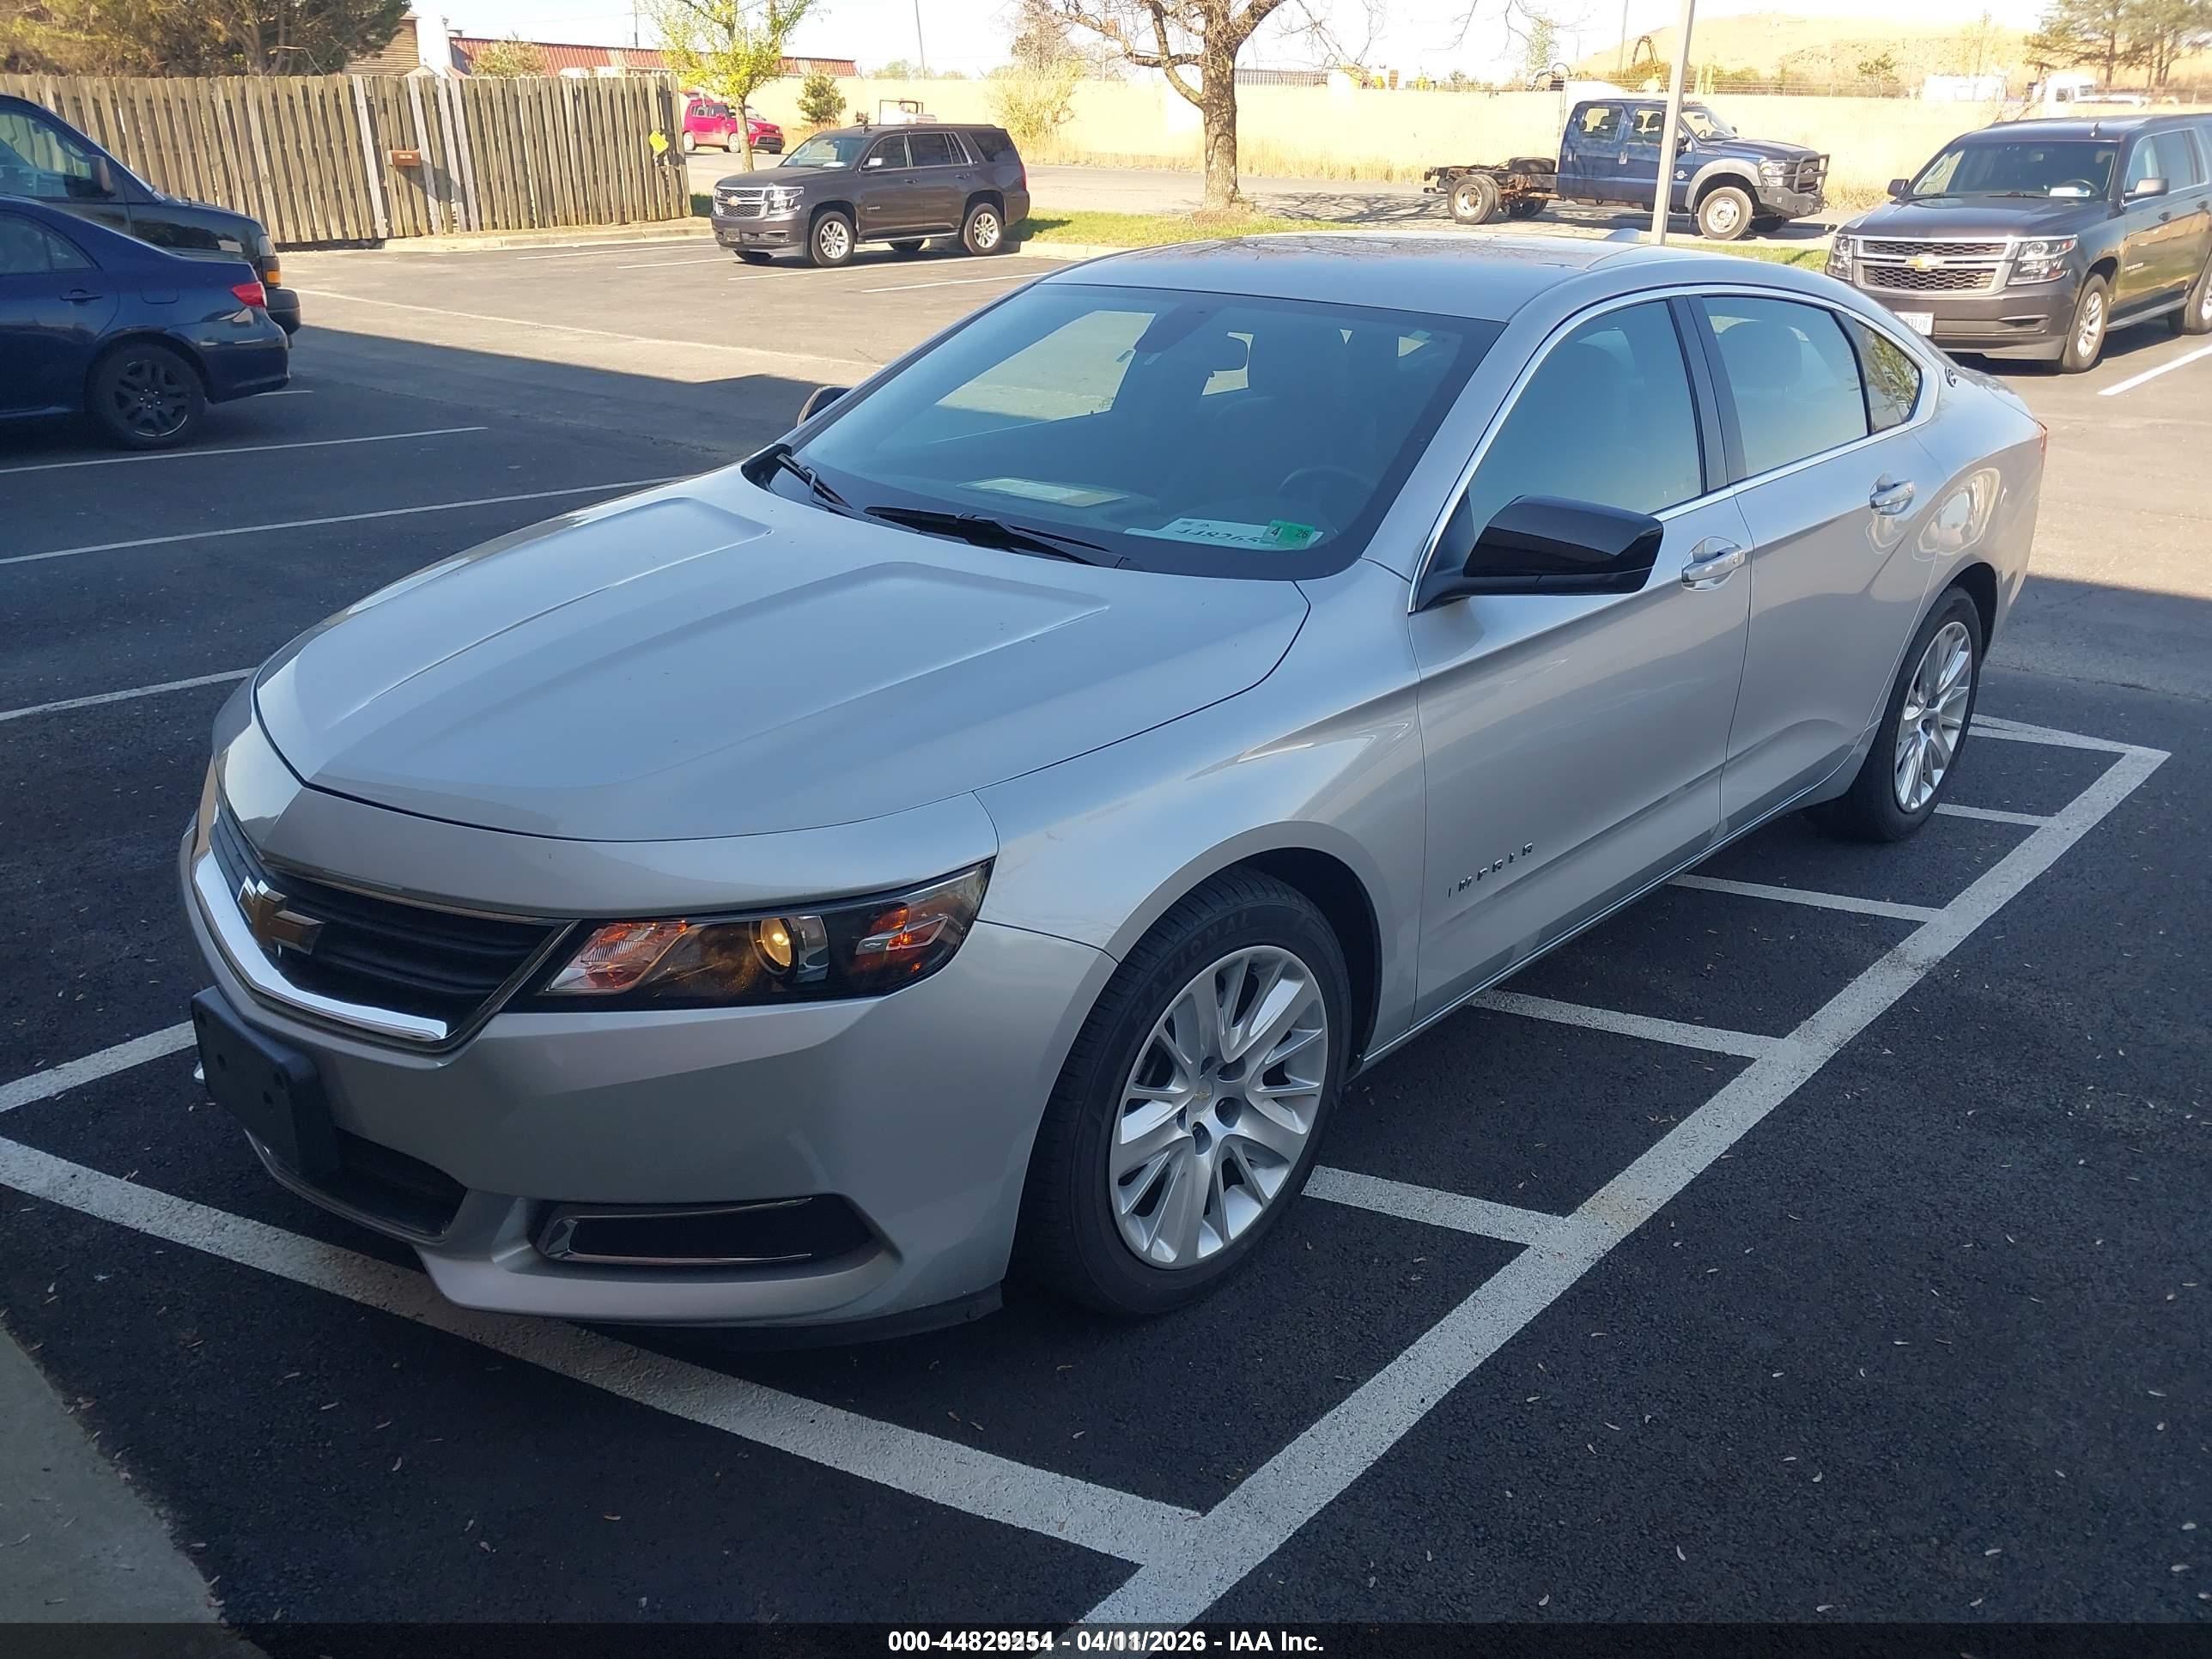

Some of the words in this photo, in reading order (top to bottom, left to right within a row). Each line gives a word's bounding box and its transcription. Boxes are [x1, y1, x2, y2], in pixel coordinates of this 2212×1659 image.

[1270, 526, 1281, 537] 4
[1296, 529, 1310, 539] 26
[1447, 842, 1534, 899] IMPALA
